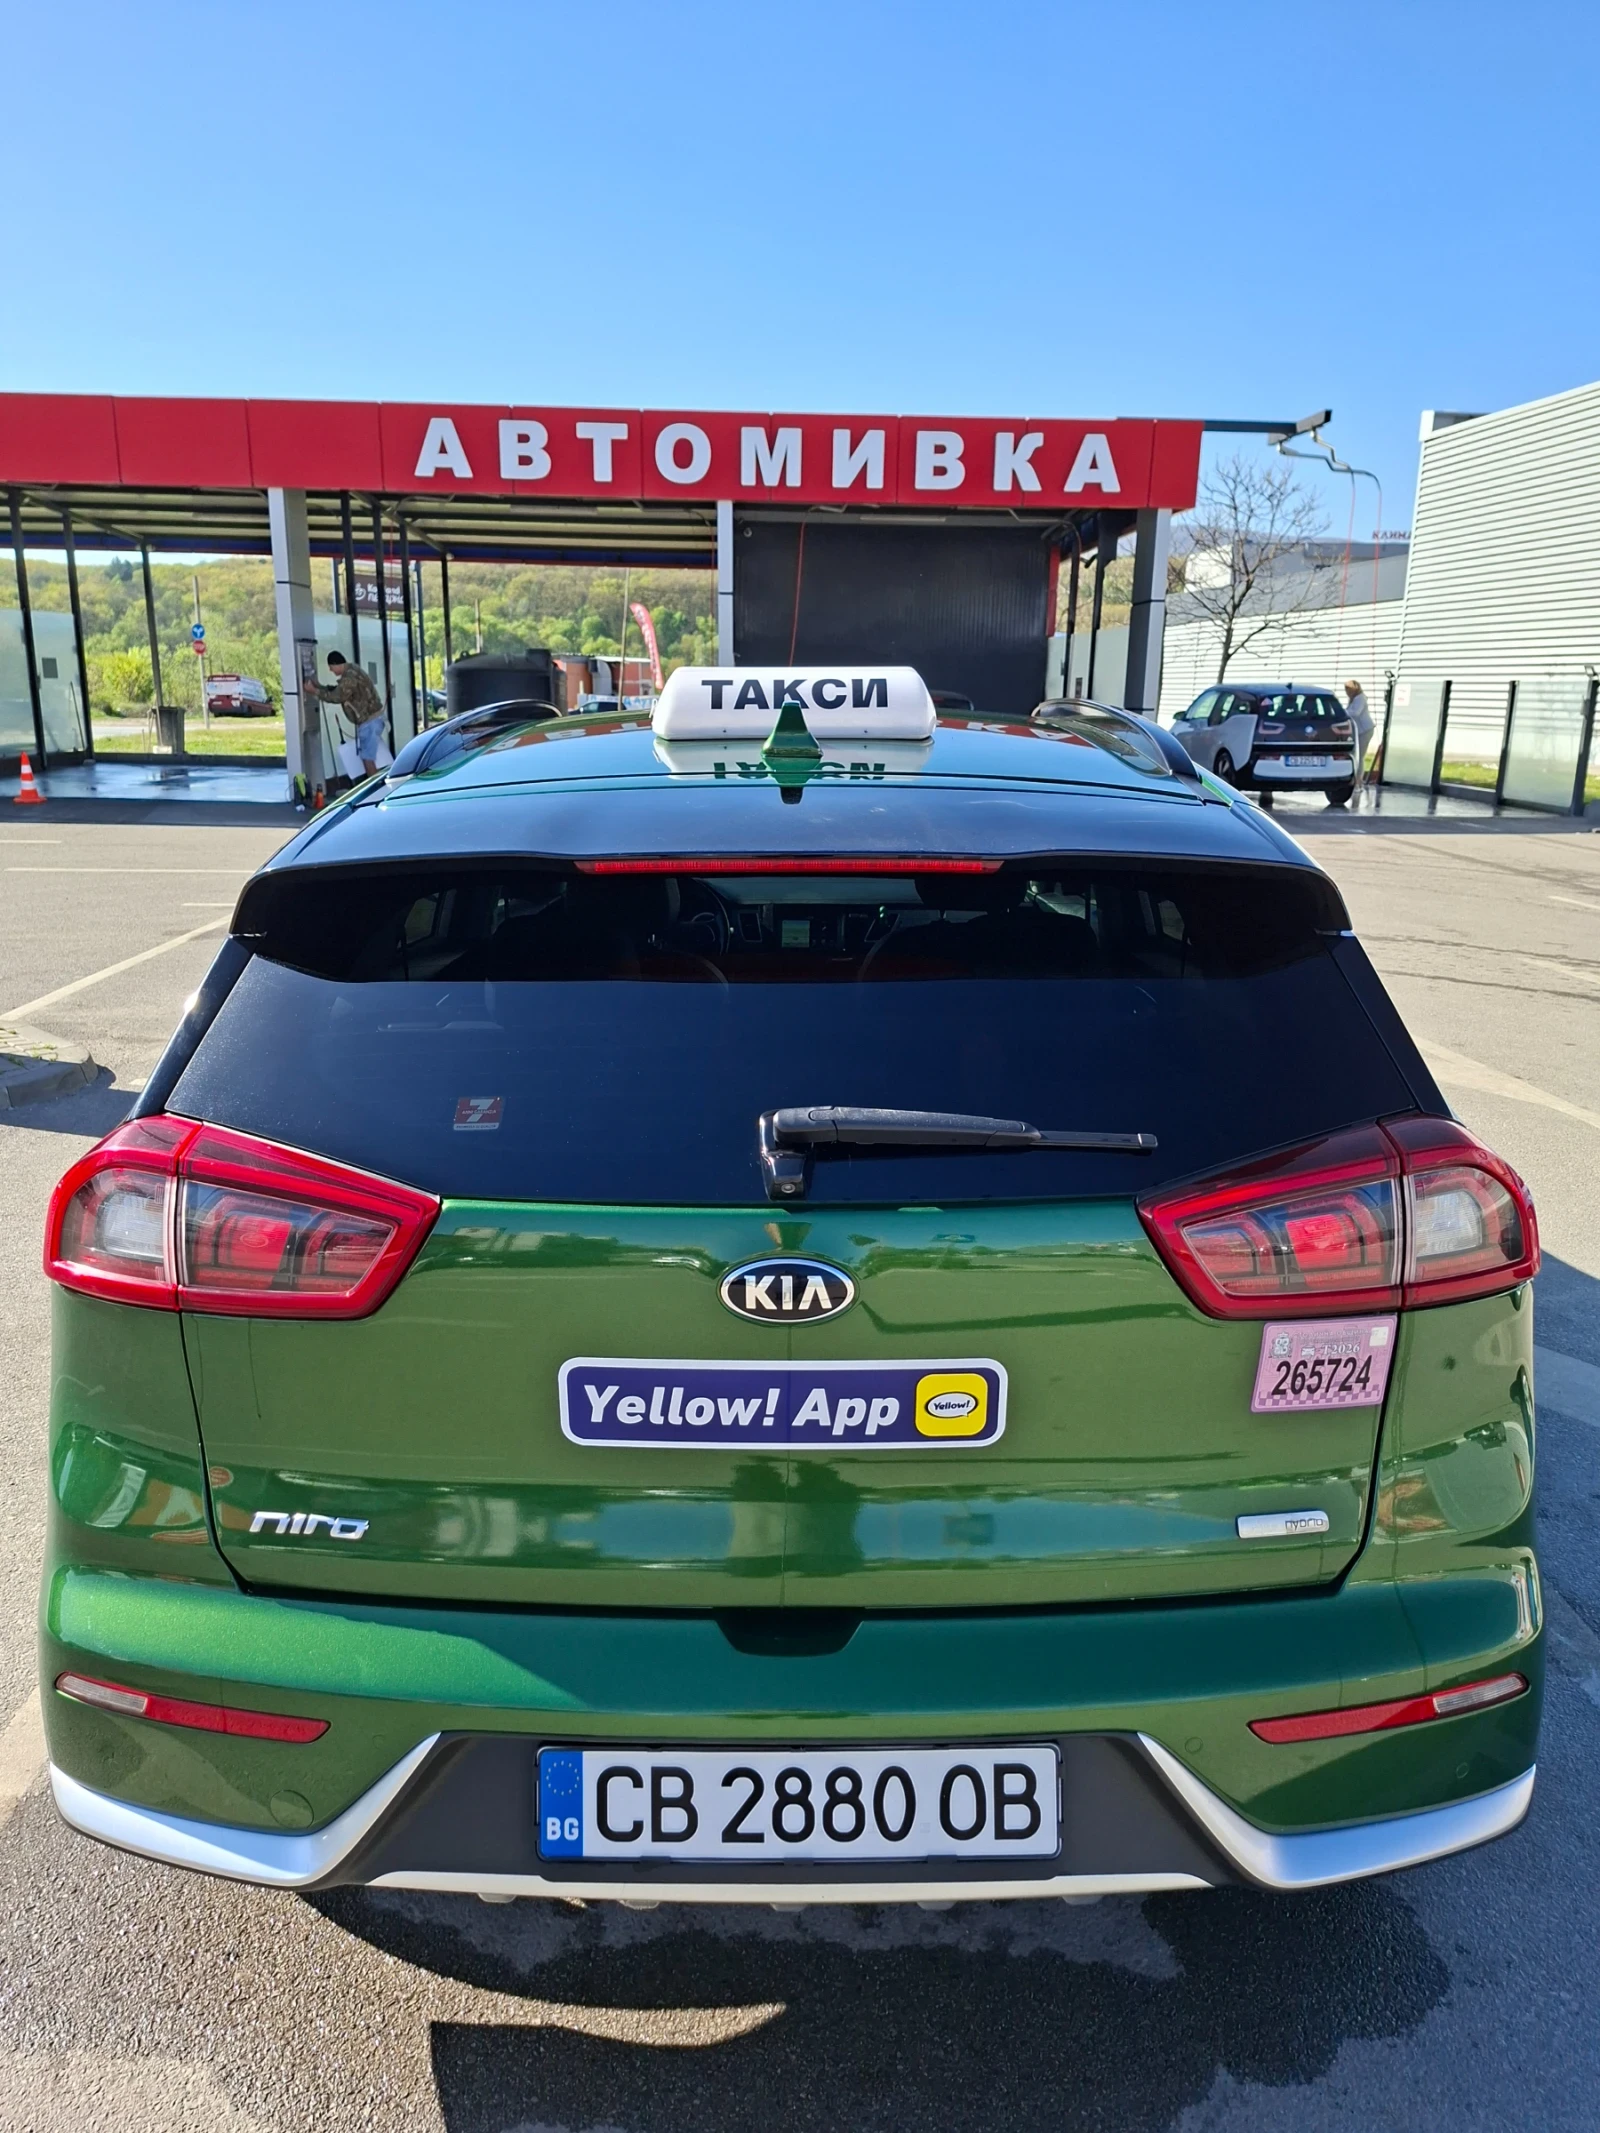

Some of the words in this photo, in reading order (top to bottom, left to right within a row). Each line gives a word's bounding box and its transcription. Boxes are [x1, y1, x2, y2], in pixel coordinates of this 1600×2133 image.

[414, 417, 1122, 493] АВТОМИВКА
[367, 583, 400, 594] Kaand
[701, 678, 889, 710] ТАКСИ
[743, 1275, 832, 1310] KIA
[1322, 1342, 1360, 1355] T2026
[1271, 1354, 1373, 1396] 265724
[584, 1384, 781, 1426] Yellow!
[792, 1388, 900, 1436] App
[933, 1400, 971, 1411] Yellow!
[249, 1511, 370, 1540] niro
[596, 1765, 699, 1843] CB
[720, 1765, 917, 1843] 2880
[938, 1763, 1042, 1841] OB
[546, 1817, 580, 1841] BG
